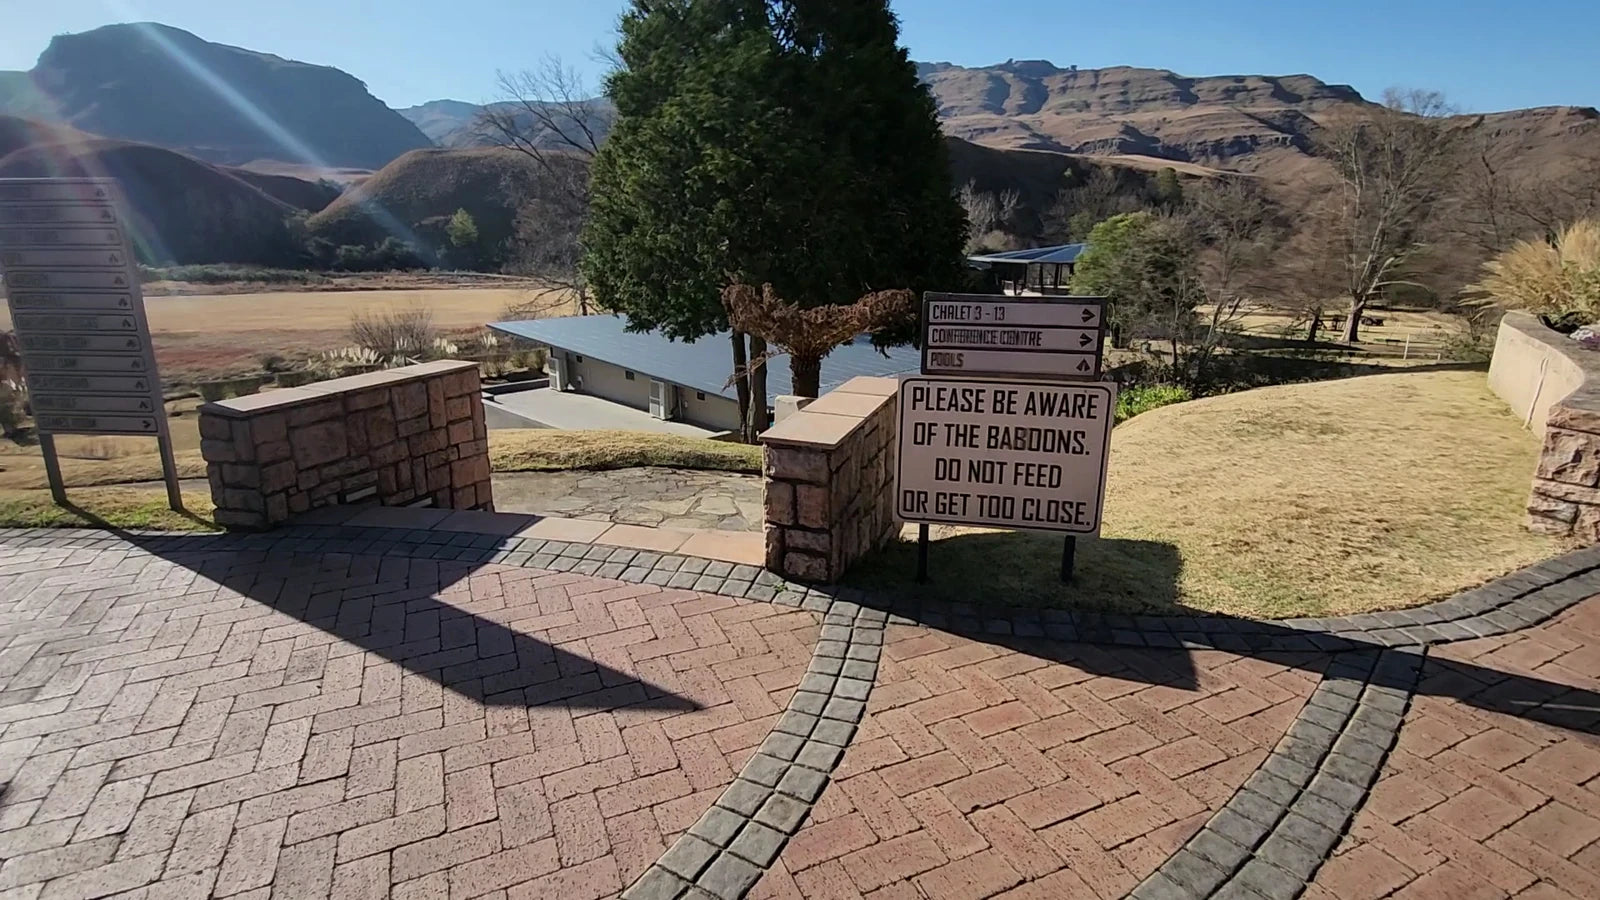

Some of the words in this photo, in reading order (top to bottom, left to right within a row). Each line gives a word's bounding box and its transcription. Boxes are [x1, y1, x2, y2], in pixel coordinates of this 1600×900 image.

[933, 305, 971, 320] CHALET
[974, 306, 982, 320] 3
[994, 307, 1005, 321] 13
[931, 352, 964, 367] POOLS
[912, 387, 986, 413] PLEASE
[993, 390, 1018, 414] BE
[1024, 391, 1099, 419] AWARE
[913, 422, 938, 445] OF
[944, 423, 980, 448] THE
[987, 426, 1090, 455] BABOONS.
[935, 458, 961, 482] DO
[968, 460, 1007, 484] NOT
[1014, 463, 1062, 488] FEED
[903, 490, 928, 513] OR
[936, 492, 970, 516] GET
[977, 495, 1015, 519] TOO
[1022, 498, 1090, 526] CLOSE.
